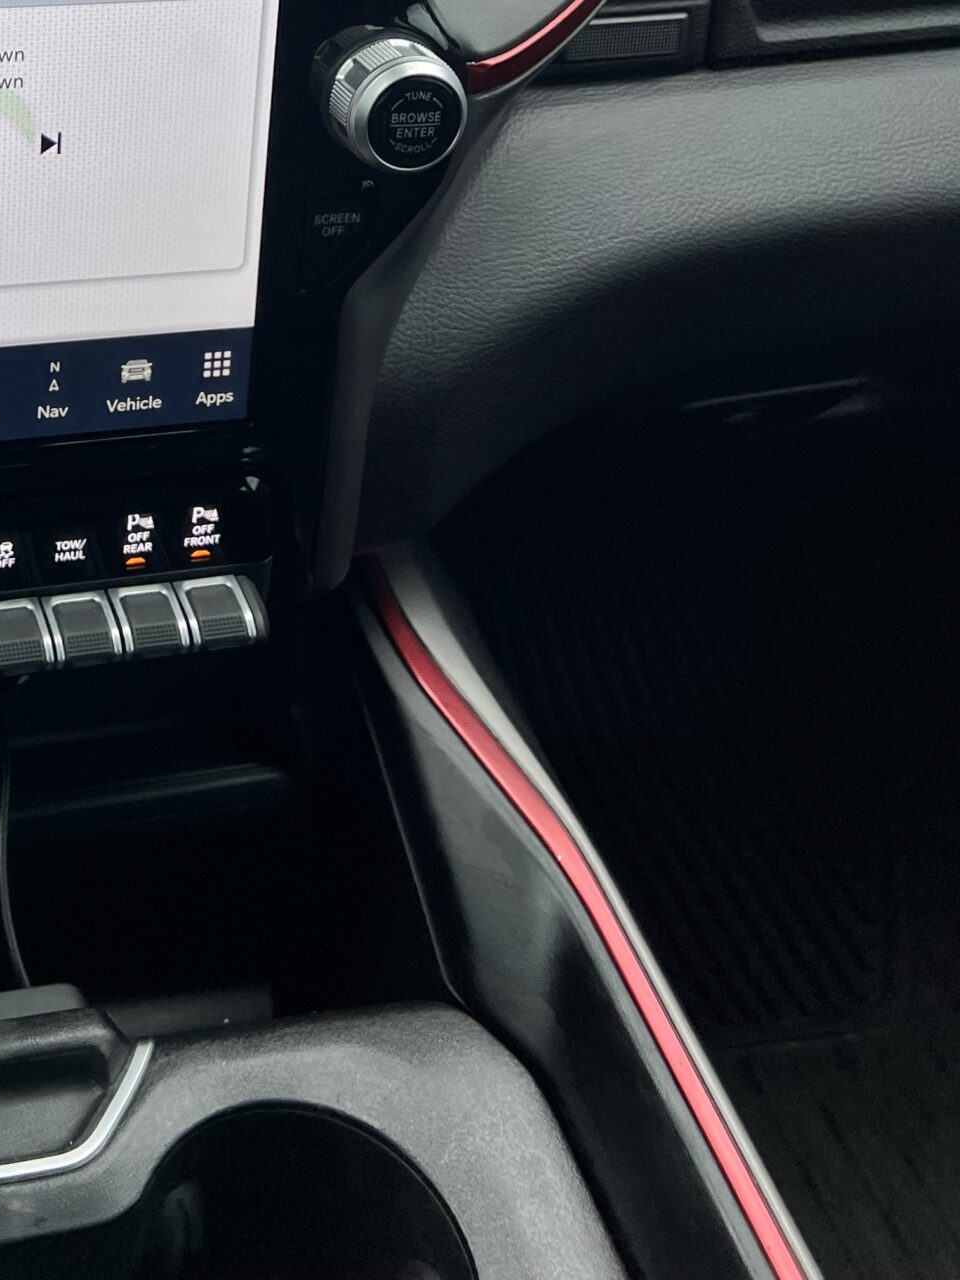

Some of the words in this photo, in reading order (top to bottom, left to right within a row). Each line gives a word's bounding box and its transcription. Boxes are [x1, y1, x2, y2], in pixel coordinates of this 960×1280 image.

[405, 91, 432, 102] TUNE
[391, 111, 442, 124] BROWSE
[396, 127, 435, 139] ENTER
[394, 141, 432, 153] SCROLL
[314, 213, 361, 225] SCREEN
[322, 227, 345, 237] OFF
[106, 395, 162, 413] Vehicle
[195, 390, 234, 407] Apps
[37, 404, 69, 420] Nav
[192, 524, 215, 535] OFF
[127, 532, 151, 543] OFF
[184, 534, 221, 547] FRONT
[55, 539, 87, 551] TOW/
[123, 542, 152, 554] REAR
[54, 549, 86, 562] HAUL
